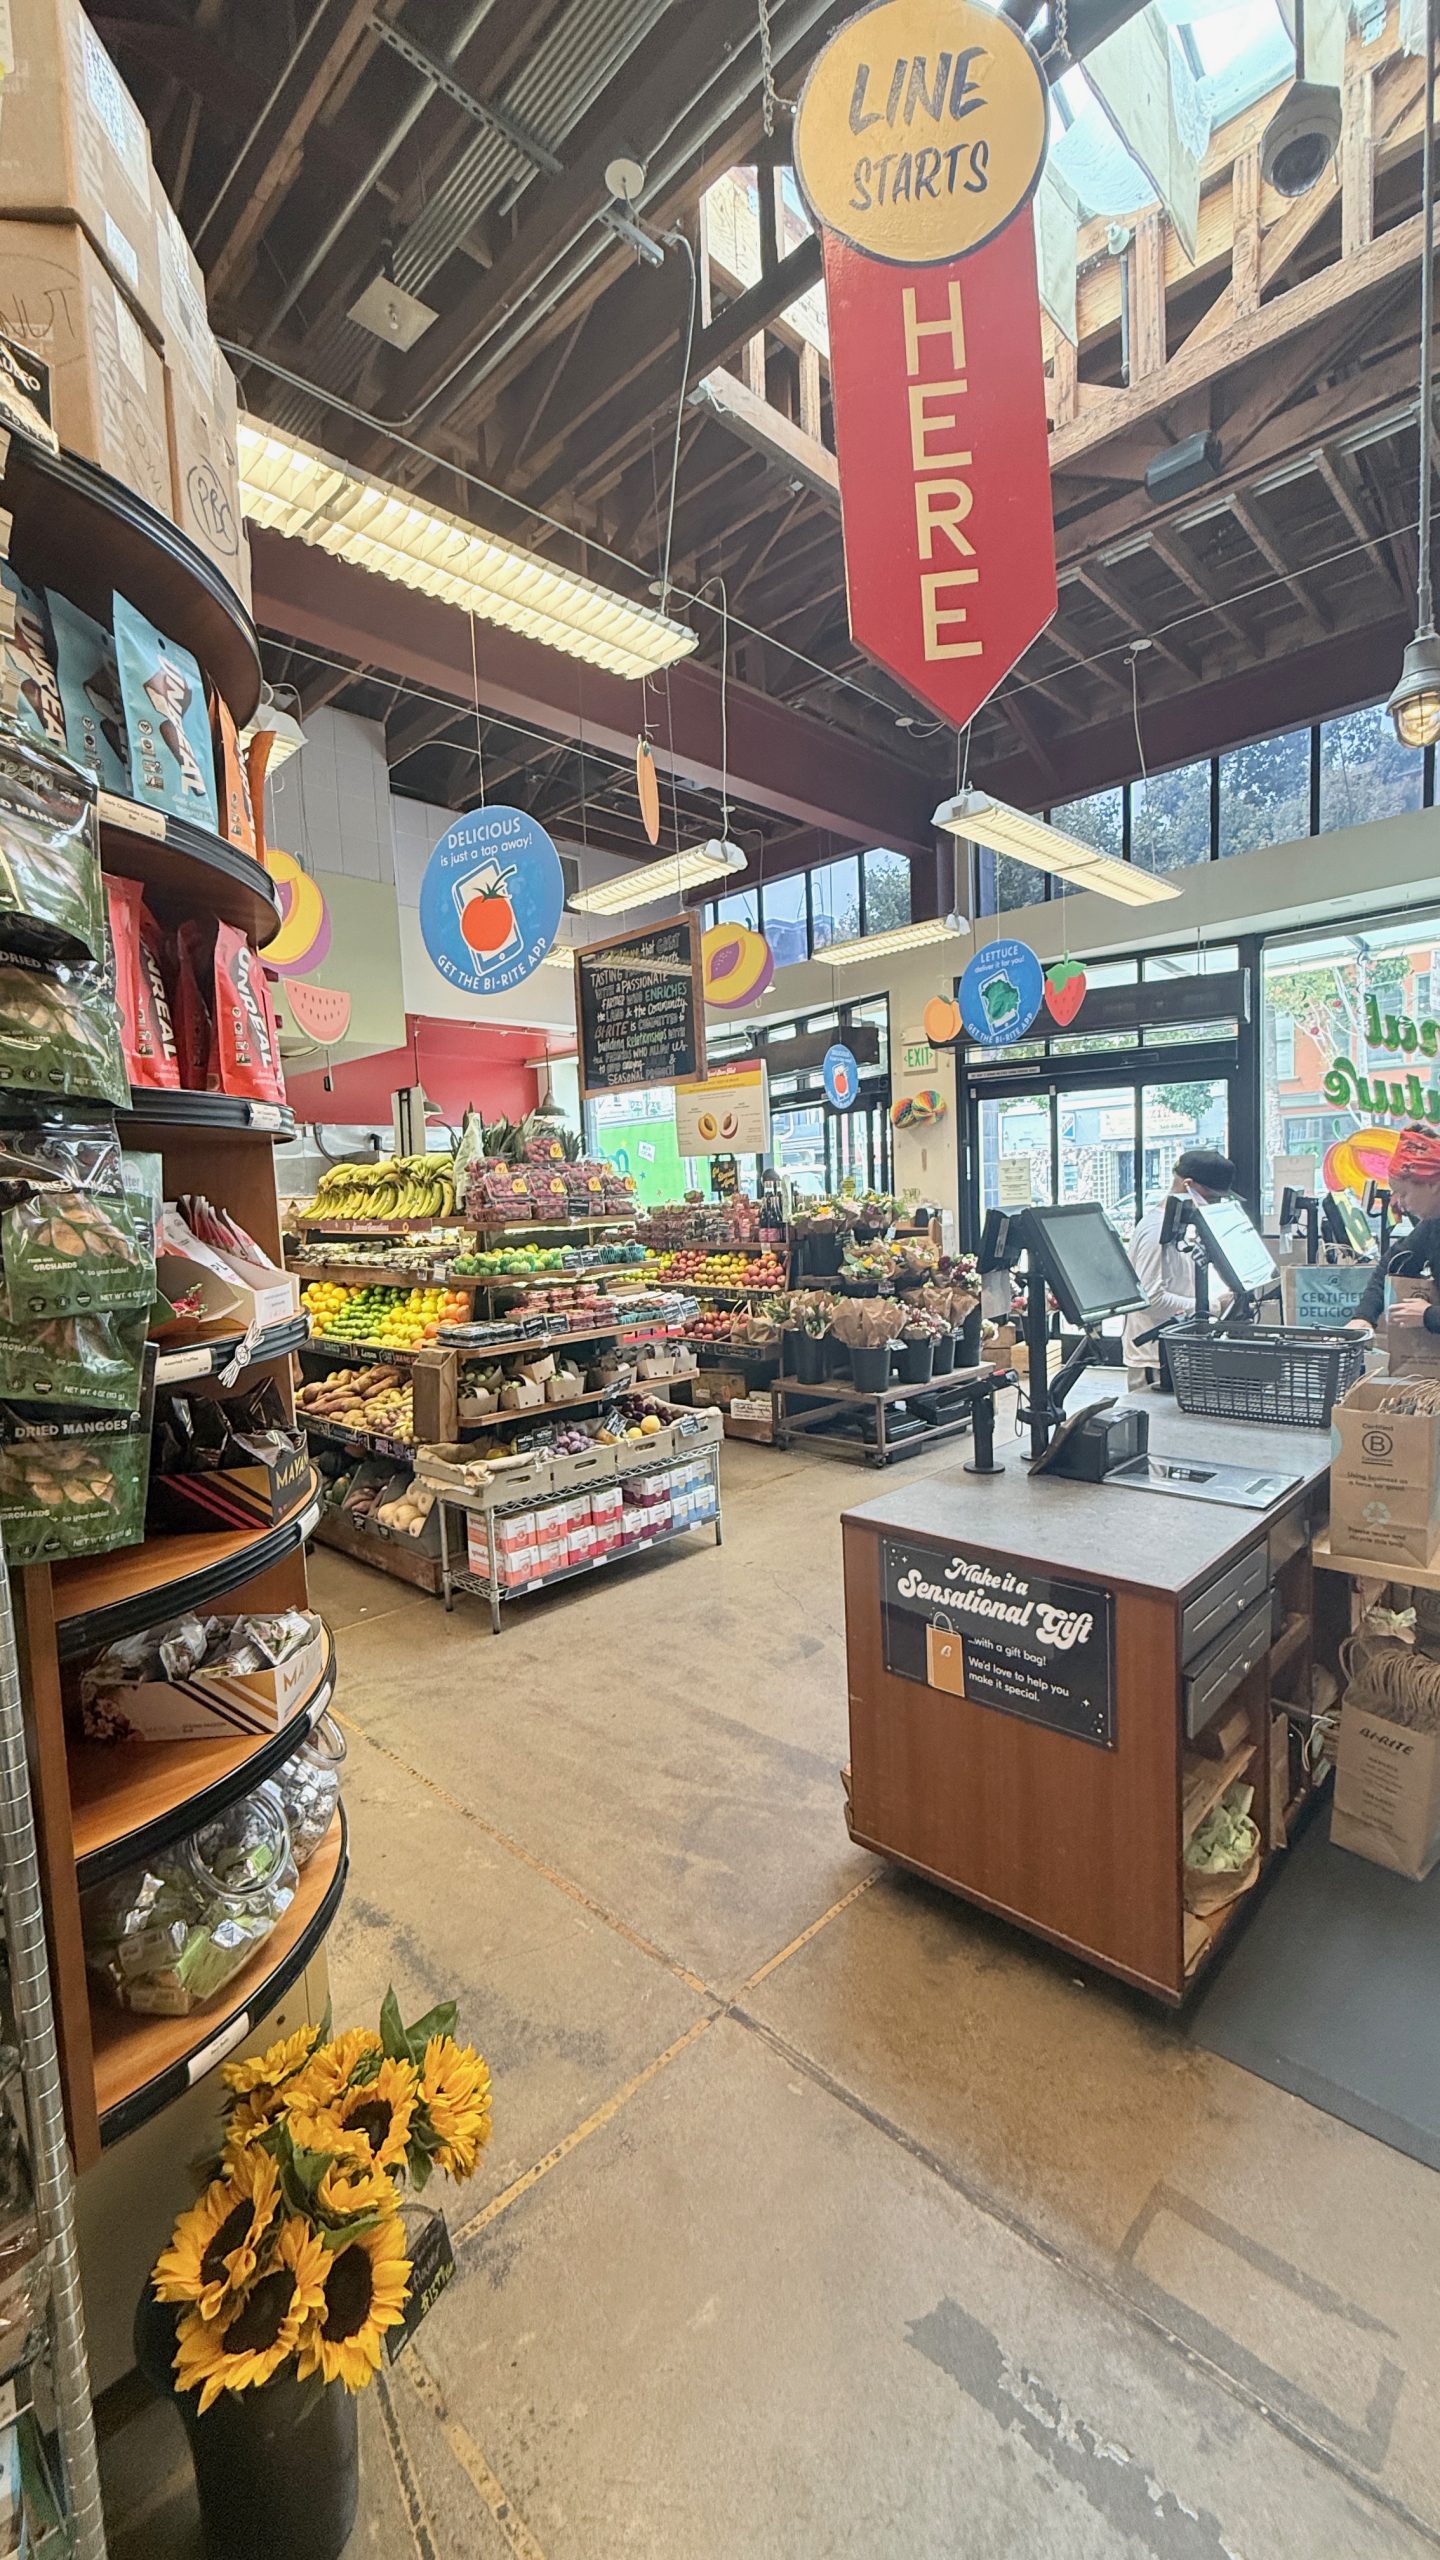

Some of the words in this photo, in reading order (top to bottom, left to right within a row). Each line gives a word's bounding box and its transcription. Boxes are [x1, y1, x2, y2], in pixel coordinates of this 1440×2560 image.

[848, 46, 989, 136] LINE
[848, 140, 989, 212] STARTS
[900, 281, 984, 661] HERE
[157, 654, 206, 796] UNREAL
[448, 817, 521, 850] DELICIOUS
[440, 855, 449, 867] is
[450, 851, 468, 868] just
[471, 851, 478, 860] a
[481, 845, 498, 858] tap
[501, 832, 533, 852] away!
[437, 954, 458, 977] GET
[458, 971, 480, 990] THE
[483, 962, 527, 991] BI-RITE
[528, 937, 547, 967] APP
[980, 945, 1019, 963] LETTUCE
[590, 969, 623, 988] TASTING
[622, 972, 669, 993] PASSIONATE
[645, 982, 687, 1002] ENRICHES
[236, 946, 274, 1068] UNREAL
[634, 1003, 647, 1018] the
[594, 1020, 629, 1039] BI-RITE
[967, 1023, 980, 1036] GET
[980, 1032, 993, 1043] THE
[995, 1027, 1021, 1044] BI-RITE
[1021, 1012, 1033, 1029] APP
[633, 1046, 648, 1057] WHO
[907, 1046, 930, 1067] EXIT
[607, 1067, 644, 1086] SEASONAL
[33, 1262, 78, 1272] ORCHARDS
[100, 1293, 114, 1302] NET
[1301, 1291, 1366, 1305] CERTIFIE
[1299, 1305, 1354, 1319] DELICIO
[63, 1385, 78, 1394] NET
[15, 1425, 60, 1438] DRIED
[63, 1419, 128, 1436] MANGOES
[1370, 1435, 1386, 1452] B
[944, 1557, 1002, 1589] Make
[1001, 1572, 1017, 1593] it
[1015, 1581, 1030, 1596] a
[897, 1569, 1036, 1628] Sensational
[1035, 1602, 1095, 1651] Gift
[996, 1644, 1003, 1652] a
[1004, 1644, 1021, 1660] gift
[1023, 1649, 1047, 1667] bag!
[968, 1655, 992, 1673] We'd
[993, 1663, 1013, 1679] love
[1014, 1670, 1025, 1683] to
[1027, 1674, 1049, 1691] help
[1050, 1683, 1070, 1698] you
[968, 1671, 994, 1688] make
[995, 1677, 1003, 1690] it
[1004, 1682, 1041, 1703] special.
[1358, 1727, 1415, 1757] BI-RITE
